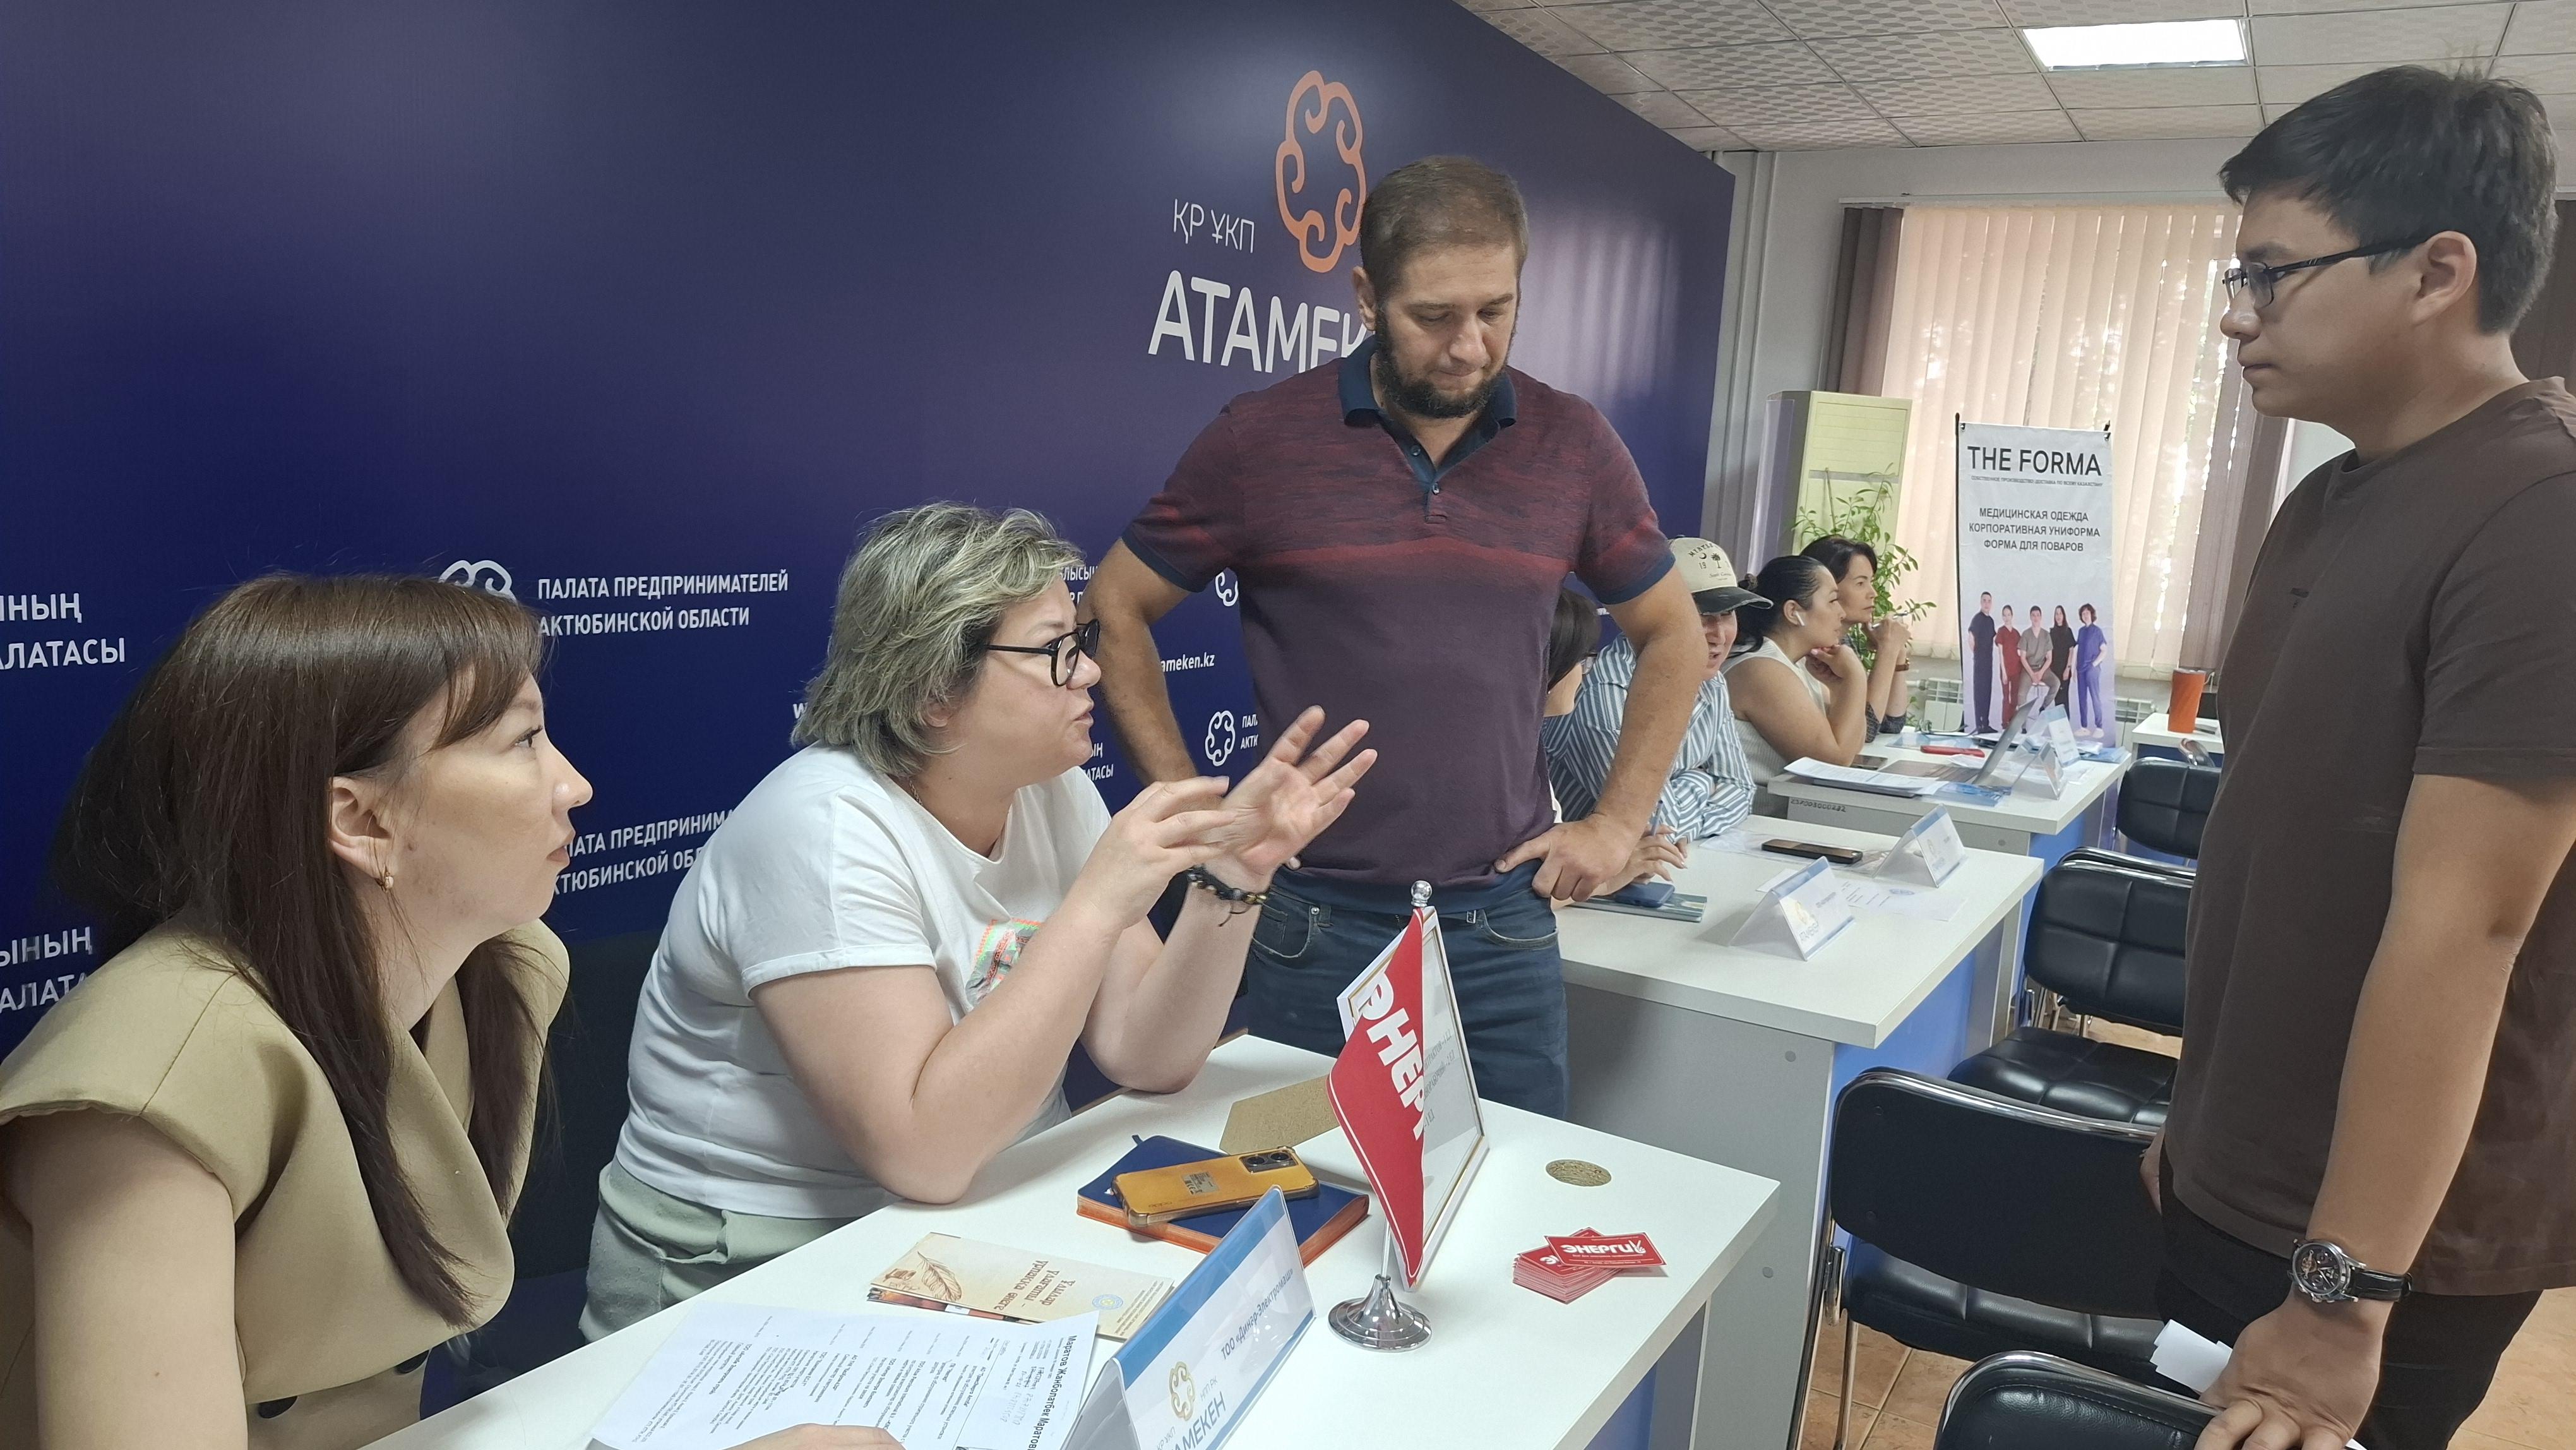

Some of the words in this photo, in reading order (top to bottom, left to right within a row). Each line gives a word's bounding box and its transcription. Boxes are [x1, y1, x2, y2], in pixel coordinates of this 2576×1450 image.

[1173, 199, 1205, 244] ҚР
[1967, 446, 2012, 471] THE
[2019, 449, 2102, 476] FORMA
[1979, 507, 2048, 520] МЕДИЦИНСКАЯ
[2051, 511, 2089, 522] ОДЕЖДА
[1969, 523, 2046, 536] КОРПОРАТИВНАЯ
[2049, 526, 2101, 537] УНИФОРМА
[1984, 539, 2017, 550] ФОРМА
[2020, 541, 2038, 551] ДЛЯ
[2041, 541, 2084, 551] ПОВАРОВ
[539, 577, 610, 600] ПАЛАТА
[614, 569, 789, 600] ПРЕДПРИНИМАТЕЛЕЙ
[540, 606, 674, 637] АКТЮБИНСКОЙ
[678, 607, 749, 630] ОБЛАСТИ
[1242, 714, 1258, 728] ПАЛ
[1083, 764, 1114, 781] АТАСЫ
[611, 809, 734, 849] ПРЕДПРИНИМ
[1059, 1335, 1077, 1367] Маратов
[1221, 1338, 1235, 1360] ТОО
[1027, 1418, 1050, 1450] Маратов
